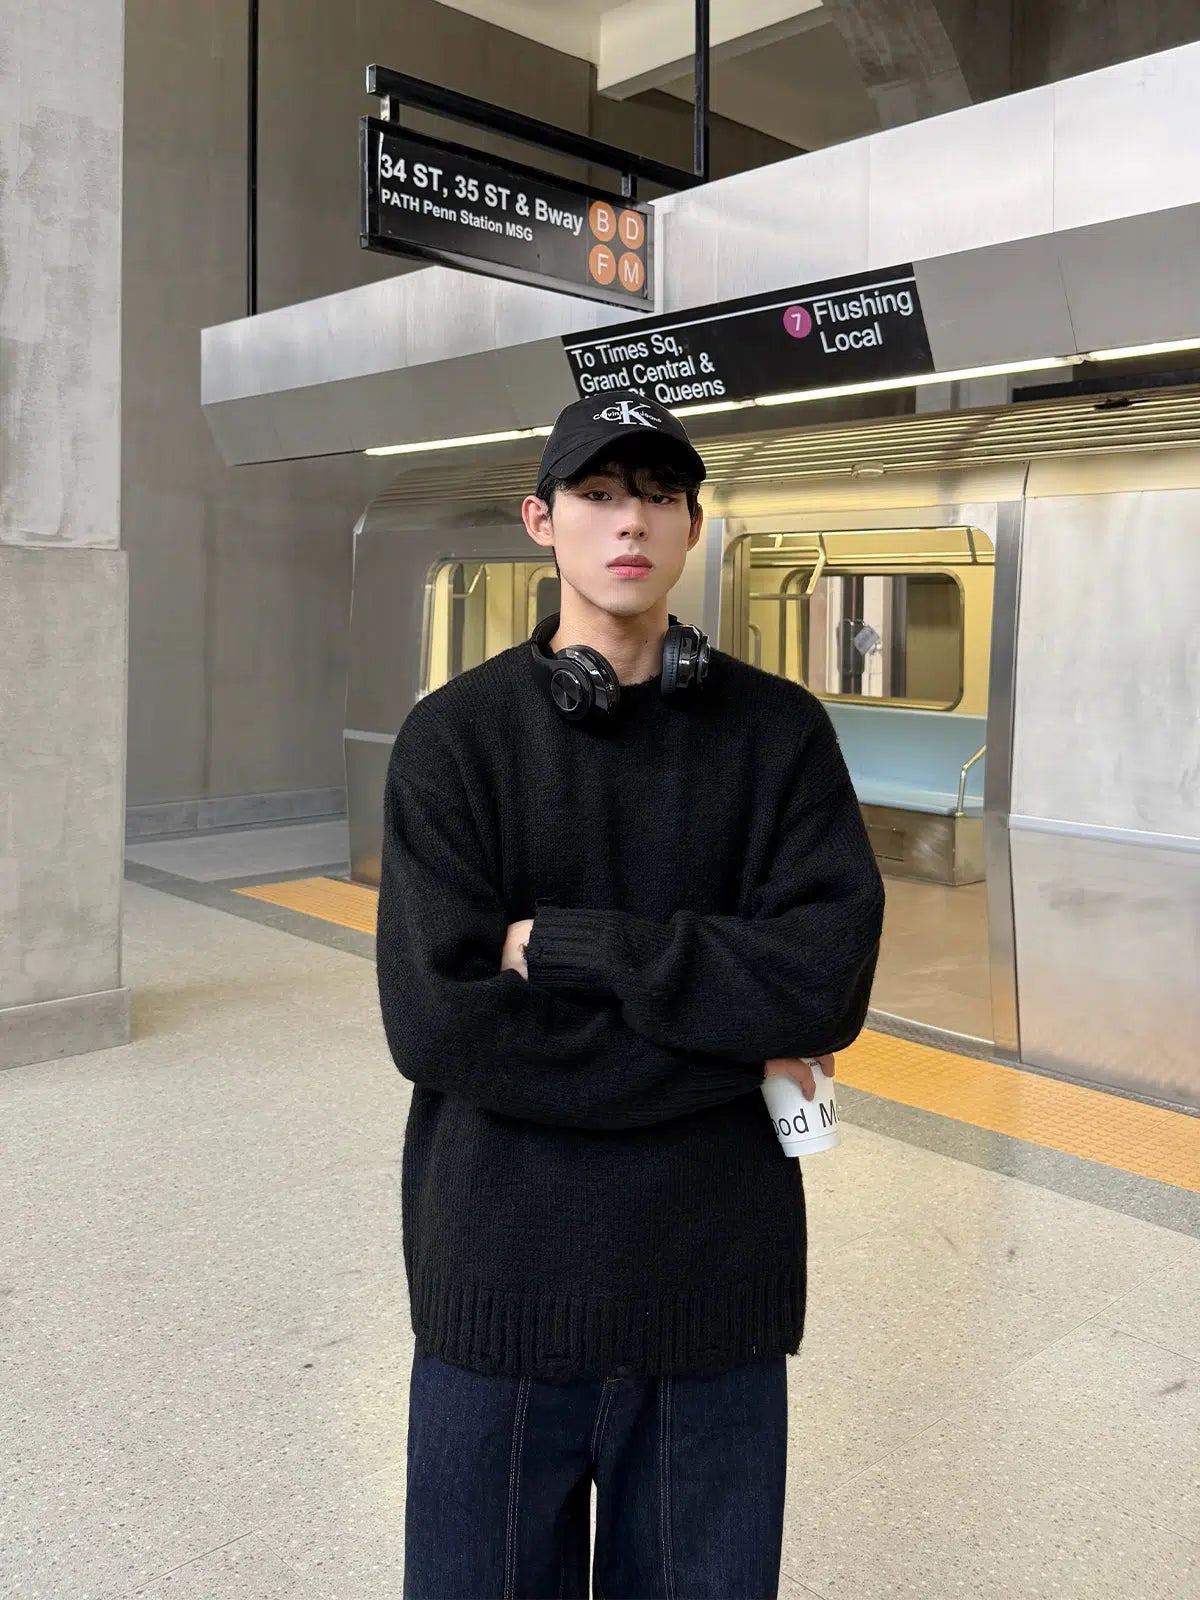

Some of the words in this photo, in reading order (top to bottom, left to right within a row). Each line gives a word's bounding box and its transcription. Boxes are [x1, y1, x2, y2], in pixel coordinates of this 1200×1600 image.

[380, 154, 408, 182] 34
[412, 163, 449, 198] ST,
[454, 175, 480, 202] 35
[484, 183, 511, 210] ST
[515, 193, 530, 217] &
[535, 198, 583, 236] Bway
[381, 189, 420, 212] PATH
[423, 199, 457, 222] Penn
[460, 209, 503, 234] Station
[505, 222, 533, 241] MSG
[596, 209, 610, 233] B
[626, 217, 639, 241] D
[597, 252, 609, 276] F
[622, 260, 640, 284] M
[791, 312, 801, 332] 7
[812, 290, 914, 325] Flushing
[570, 349, 595, 369] To
[595, 341, 649, 365] Times
[650, 333, 684, 357] Sq,
[819, 321, 884, 354] Local
[579, 367, 631, 393] Grand
[632, 355, 697, 384] Central
[698, 352, 716, 374] &
[654, 379, 727, 404] Queens
[819, 1099, 840, 1128] M
